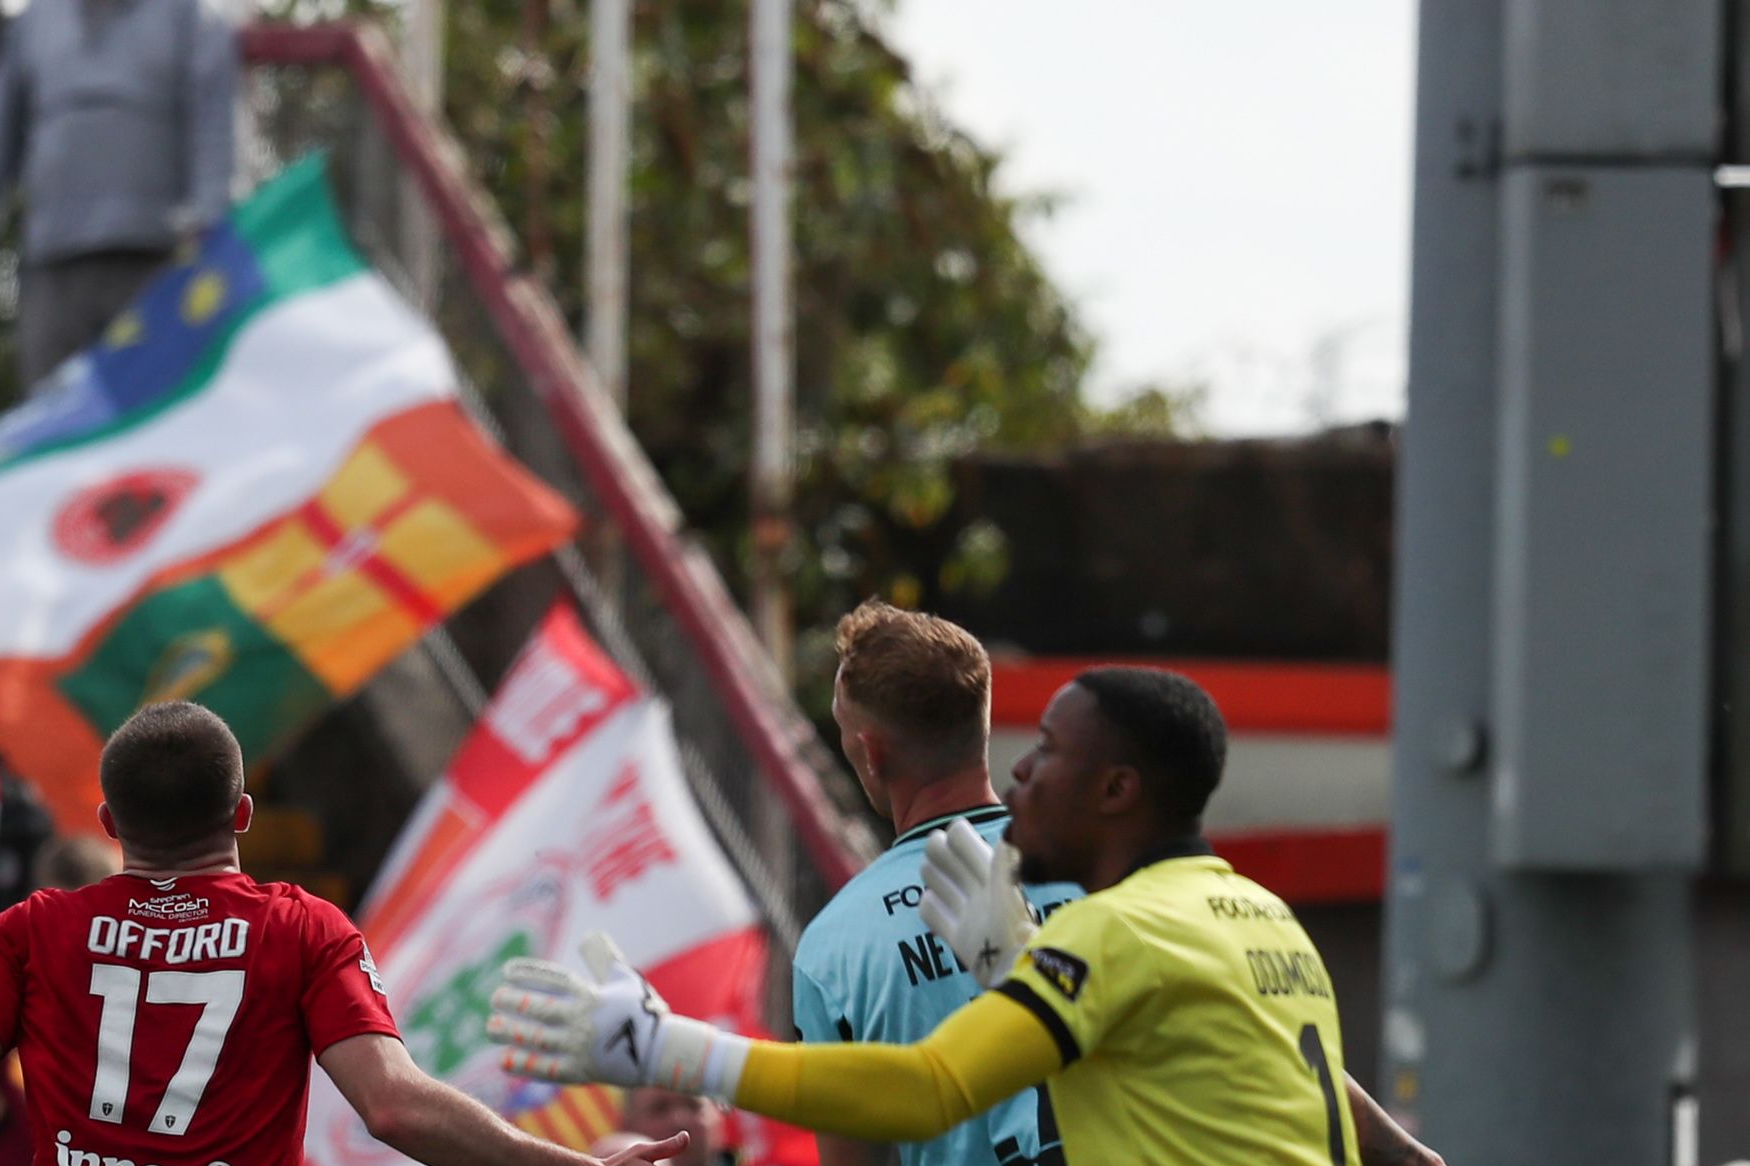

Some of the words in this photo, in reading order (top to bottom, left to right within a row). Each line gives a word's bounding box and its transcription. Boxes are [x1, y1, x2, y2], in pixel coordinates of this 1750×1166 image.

[128, 897, 209, 913] McCosh
[128, 908, 167, 920] FUNERAL
[168, 908, 209, 920] DIRECTOR
[87, 915, 250, 965] OFFORD
[89, 963, 246, 1136] 17
